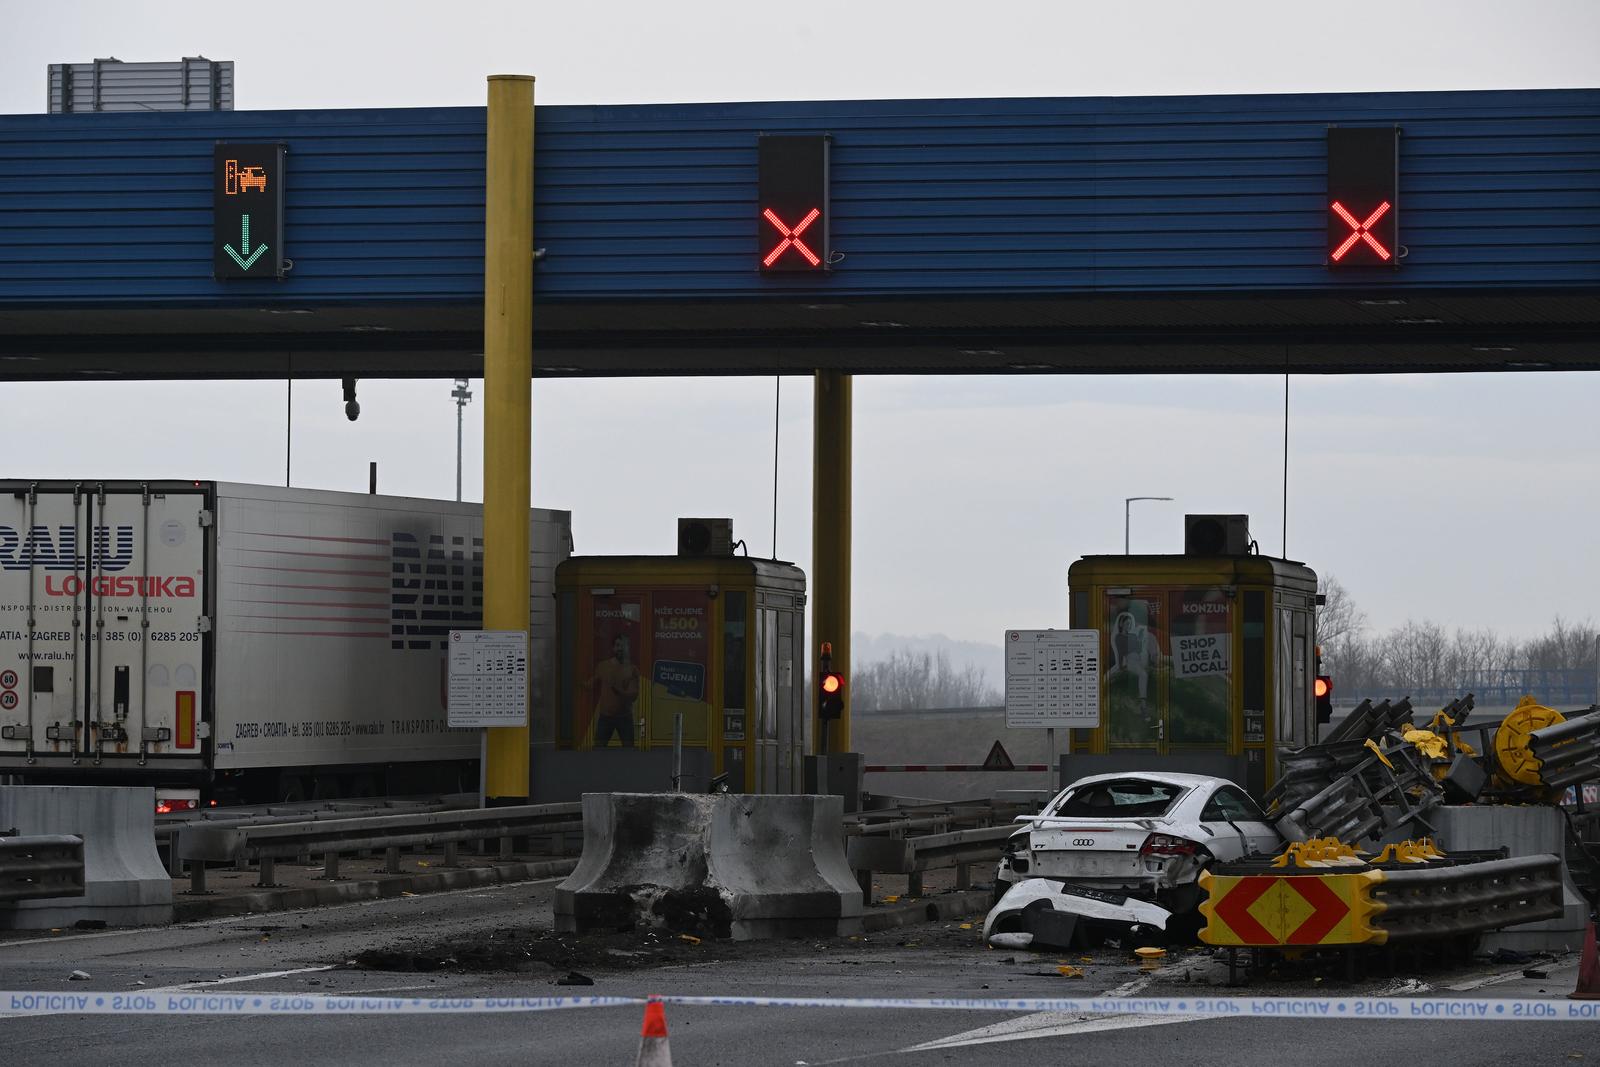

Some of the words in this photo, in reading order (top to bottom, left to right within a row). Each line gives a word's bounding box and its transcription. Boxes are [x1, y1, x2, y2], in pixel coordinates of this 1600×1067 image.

[0, 526, 133, 571] RALU
[44, 605, 119, 613] DISTRBUION
[675, 607, 704, 616] CIJENE
[1183, 604, 1230, 614] KONZUM
[659, 617, 699, 631] 1.500
[31, 631, 71, 641] ZAGREB
[106, 631, 125, 641] 385
[151, 632, 176, 642] 6285
[180, 633, 199, 642] 205
[1180, 637, 1216, 650] SHOP
[18, 651, 75, 661] www.ralu.hr
[1181, 650, 1210, 662] LIKE
[1213, 650, 1221, 660] A
[1182, 661, 1229, 674] LOCAL!
[4, 675, 14, 683] 80
[660, 671, 697, 684] CIJENA!
[4, 695, 14, 704] 70
[236, 722, 258, 738] ZAGREB
[264, 721, 288, 738] CROATIA
[302, 721, 313, 737] 385
[340, 720, 350, 736] 205
[392, 719, 435, 736] TRANSPORT
